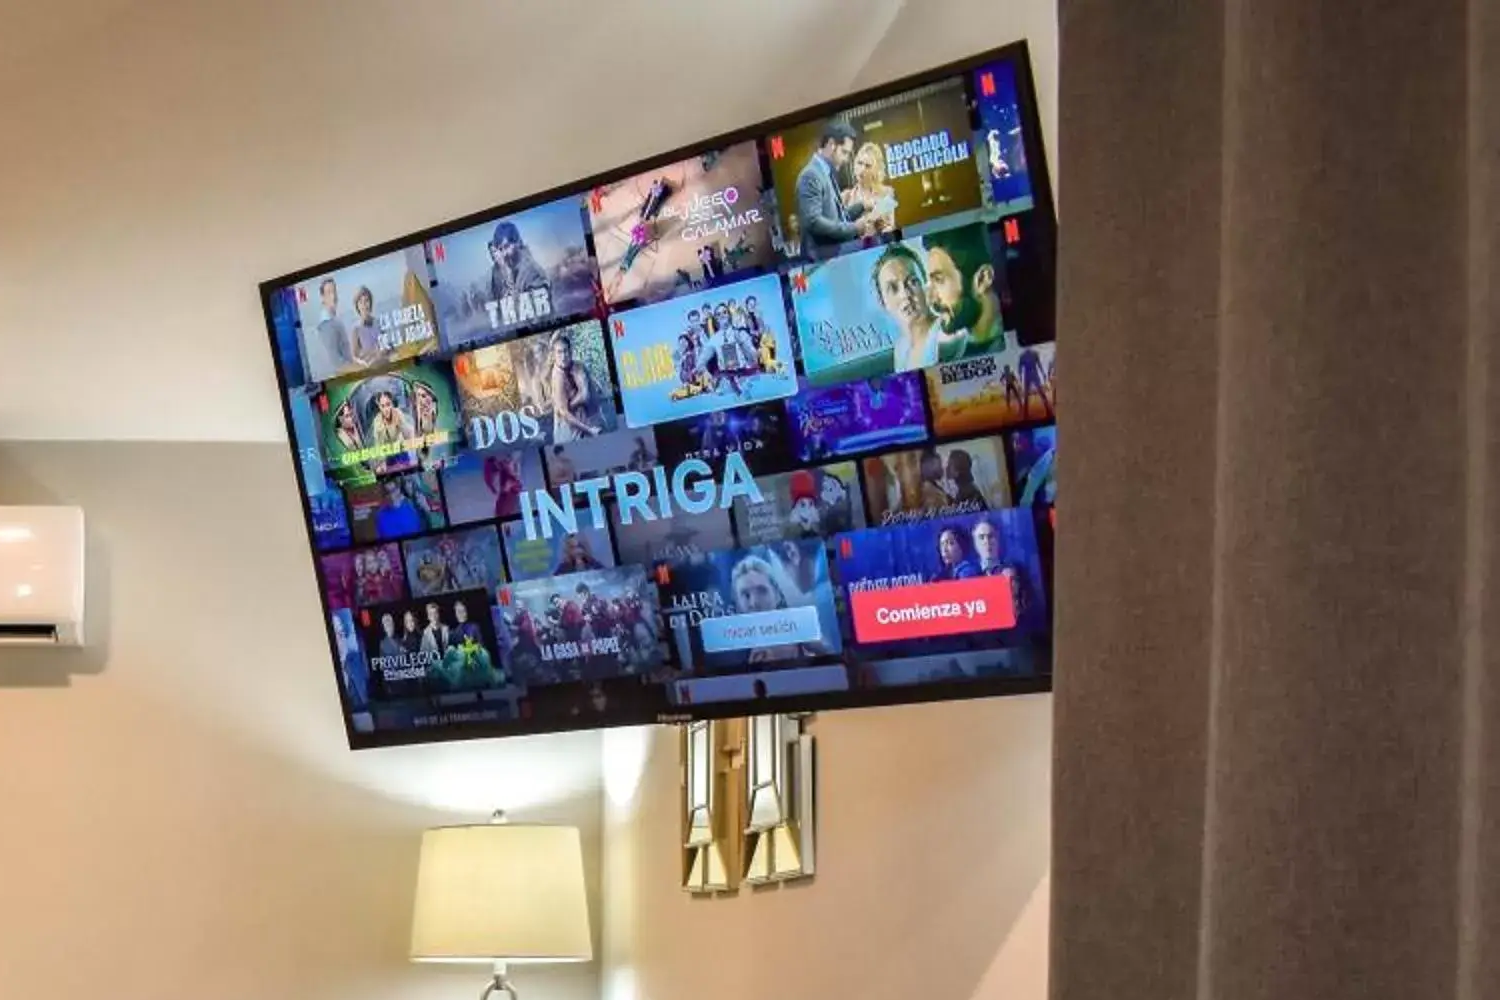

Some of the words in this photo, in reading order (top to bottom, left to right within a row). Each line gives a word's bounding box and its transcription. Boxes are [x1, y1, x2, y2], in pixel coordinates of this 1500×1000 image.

[885, 131, 949, 161] ABOGADO
[888, 157, 910, 179] DEL
[911, 142, 969, 172] LINCOLN
[681, 209, 764, 241] CALAMAR
[470, 405, 540, 450] DOS
[519, 452, 765, 541] INTRIGA
[876, 601, 962, 625] Comienza
[965, 599, 987, 619] ya
[371, 651, 441, 671] PRIVILEGIO
[541, 645, 553, 661] LA
[554, 641, 579, 660] CASA
[591, 636, 621, 654] PAPEL
